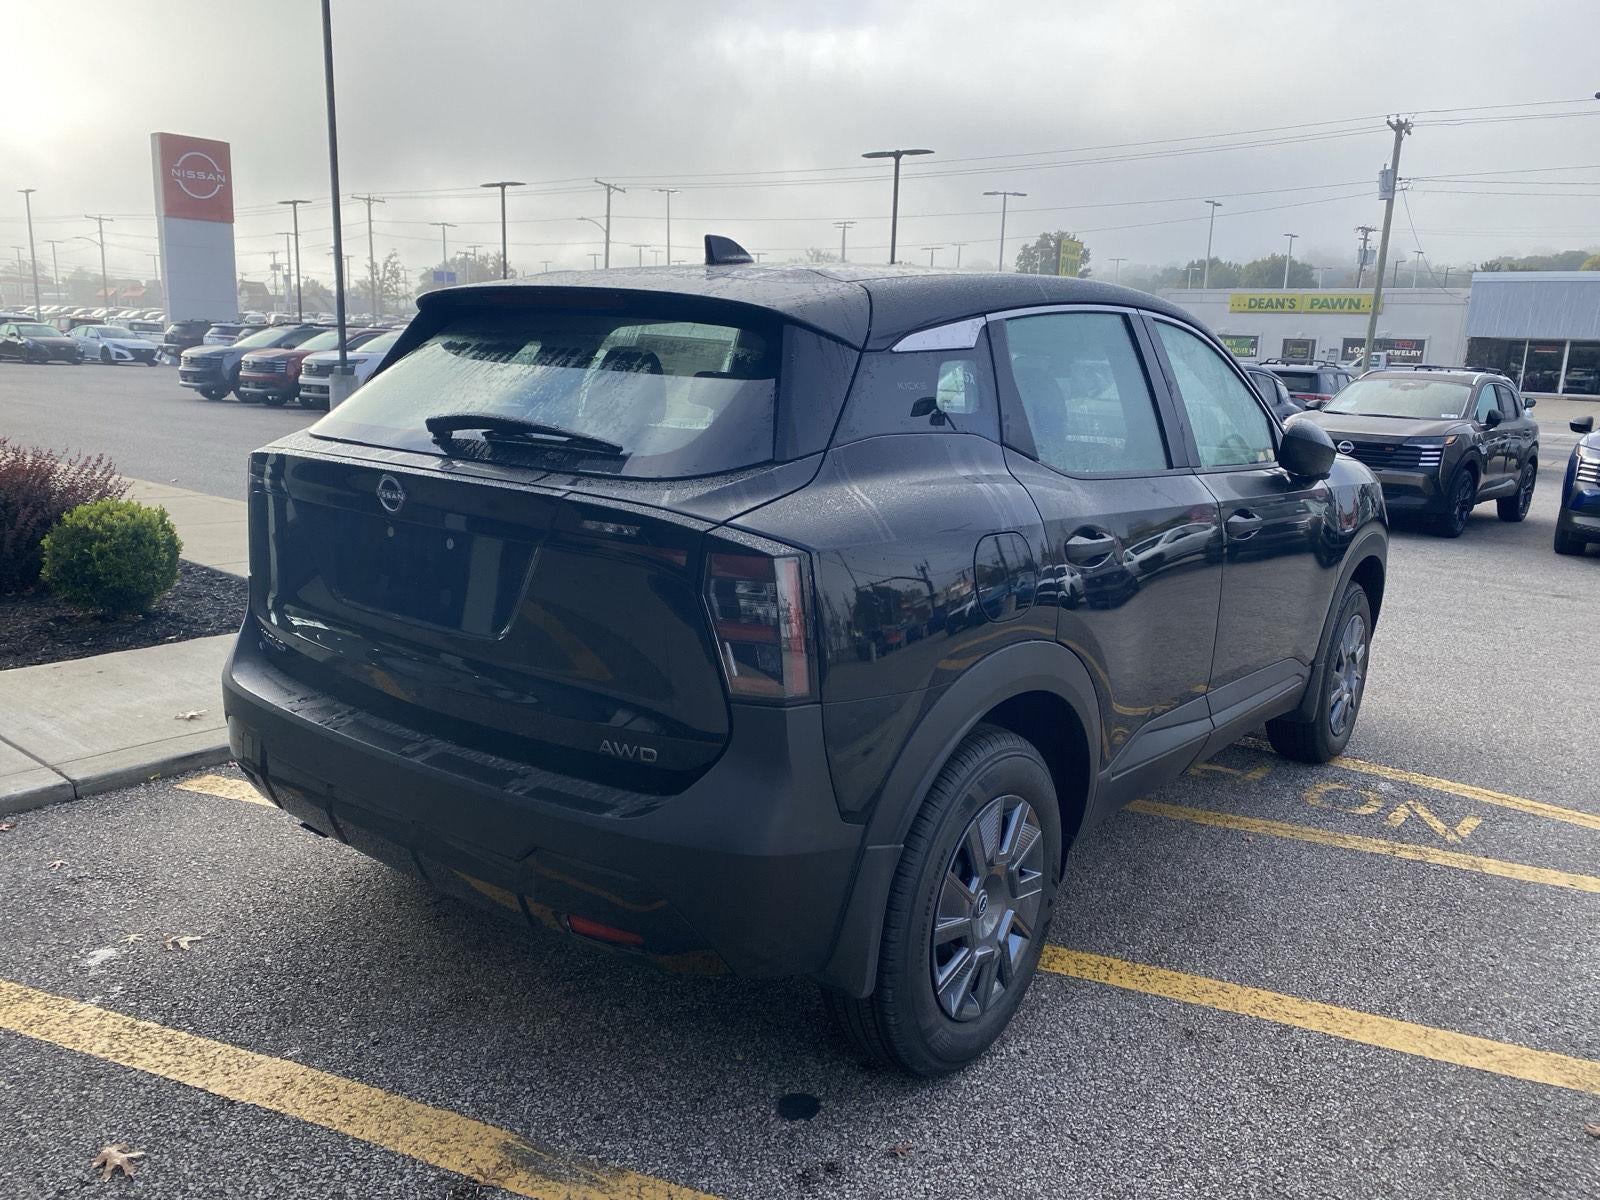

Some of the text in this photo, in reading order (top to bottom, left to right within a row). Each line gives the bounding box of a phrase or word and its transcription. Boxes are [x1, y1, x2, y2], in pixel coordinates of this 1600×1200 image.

[171, 168, 226, 184] NISSAN
[1247, 297, 1361, 310] DEAN'S PAWN
[896, 381, 928, 392] KICKS
[599, 739, 658, 762] AWD
